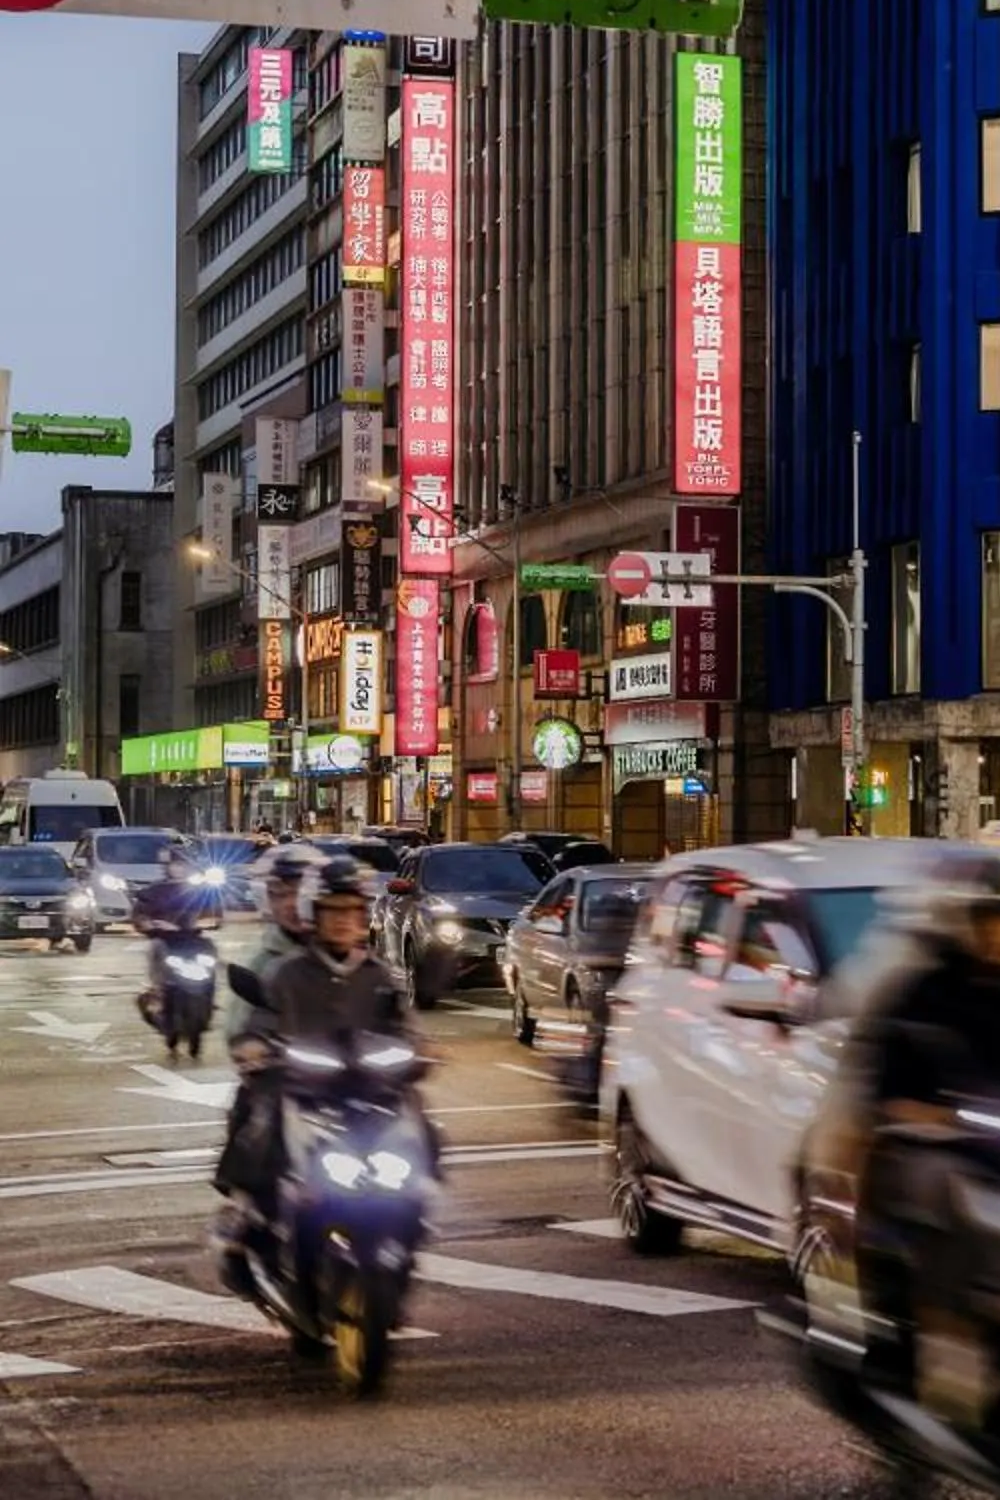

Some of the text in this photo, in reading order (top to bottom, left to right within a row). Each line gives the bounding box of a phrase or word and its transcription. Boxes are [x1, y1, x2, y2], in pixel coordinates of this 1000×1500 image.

[411, 92, 447, 173] 高點
[694, 63, 723, 197] 智勝出版
[692, 248, 724, 450] 貝塔語言出版
[411, 475, 447, 555] 高點
[266, 622, 283, 708] CAMPUS
[350, 641, 373, 711] Holiday
[615, 747, 697, 777] STARBUCKS COFFEE
